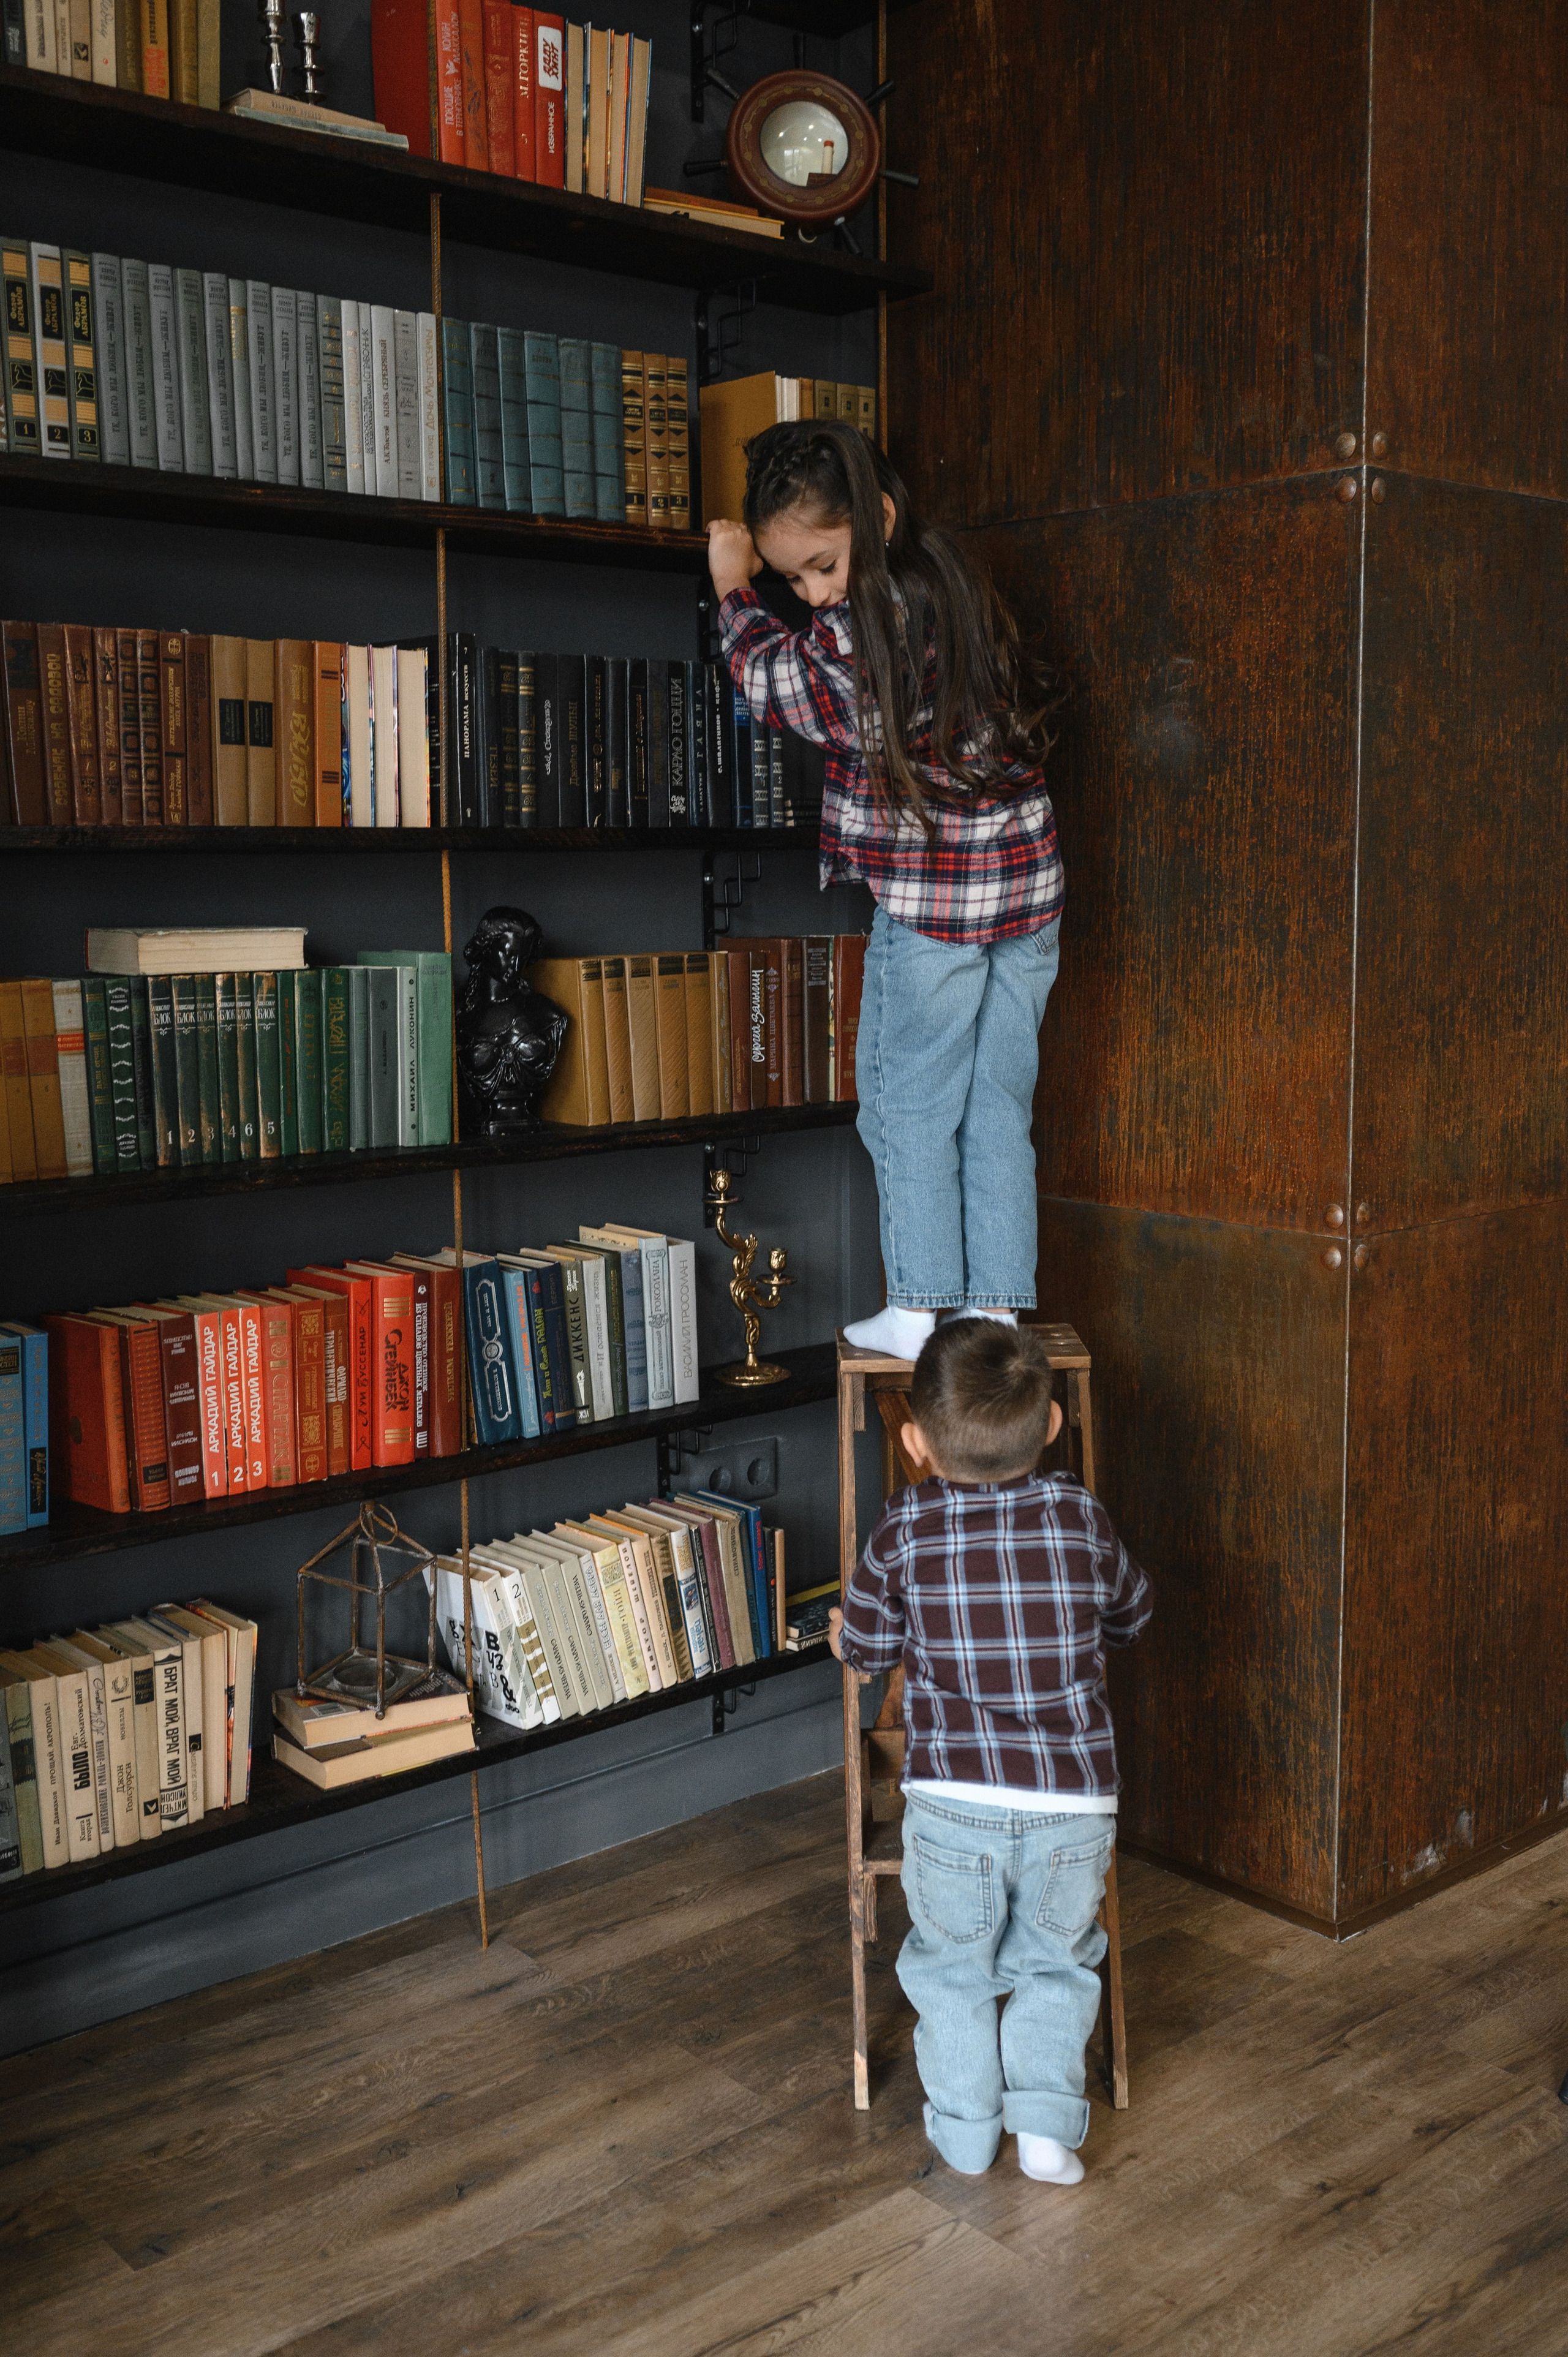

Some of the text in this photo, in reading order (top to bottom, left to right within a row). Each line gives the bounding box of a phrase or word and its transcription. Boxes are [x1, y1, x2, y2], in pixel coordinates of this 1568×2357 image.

[442, 22, 451, 52] КОЛИН
[444, 85, 454, 126] ПОЮЩИЕ
[379, 339, 389, 390] СЕРЕБРЯНЫЙ
[23, 423, 29, 436] 1
[54, 428, 61, 440] 2
[83, 430, 92, 442] 3
[671, 677, 683, 786] КАРЛО ГОЦЦИ
[154, 1012, 172, 1025] БЛОК
[176, 1012, 195, 1024] БЛОК
[197, 1011, 214, 1022] БЛОК
[221, 1009, 235, 1020] БЛОК
[236, 1008, 252, 1020] БЛОК
[258, 1008, 276, 1020] БЛОК
[167, 1130, 173, 1145] 1
[188, 1129, 195, 1143] 2
[208, 1127, 214, 1140] 3
[228, 1125, 236, 1137] 4
[244, 1123, 252, 1136] 6
[268, 1122, 274, 1135] 5
[652, 1259, 662, 1311] РОКСОЛАНА
[416, 1303, 423, 1313] ИЗ
[534, 1308, 546, 1344] ГОЛОН
[569, 1297, 584, 1363] ДИККЕНС
[682, 1326, 692, 1378] ВАСИЛИЙ
[324, 1330, 337, 1403] ТЕРАПЕВТИЧЕСКИЙ
[203, 1326, 220, 1453] АРКАДИЙ ГАЙДАР
[226, 1322, 243, 1448] АРКАДИЙ ГАЙДАР
[246, 1319, 262, 1443] АРКАДИЙ ГАЙДАР
[396, 1362, 410, 1411] ДЖОН
[273, 1373, 289, 1464] СПАРТАК
[233, 1466, 244, 1483] 2
[252, 1460, 262, 1477] 3
[211, 1471, 219, 1487] 1
[512, 1583, 521, 1599] 2
[585, 1566, 598, 1597] ДОБРА
[492, 1588, 500, 1602] 1
[593, 1600, 604, 1620] ДЛЯ
[622, 1547, 656, 1671] ВИКТОР ШЕВЕЛОВ
[43, 1702, 54, 1748] АКРОПОЛЬ!
[75, 1688, 88, 1749] Долматовский
[164, 1666, 181, 1785] БРАТ МОЙ, ВРАГ МОЙ
[70, 1732, 79, 1751] Евг.
[72, 1750, 91, 1790] БЫЛО
[125, 1762, 134, 1812] Голсуорси
[51, 1790, 60, 1825] Давидков
